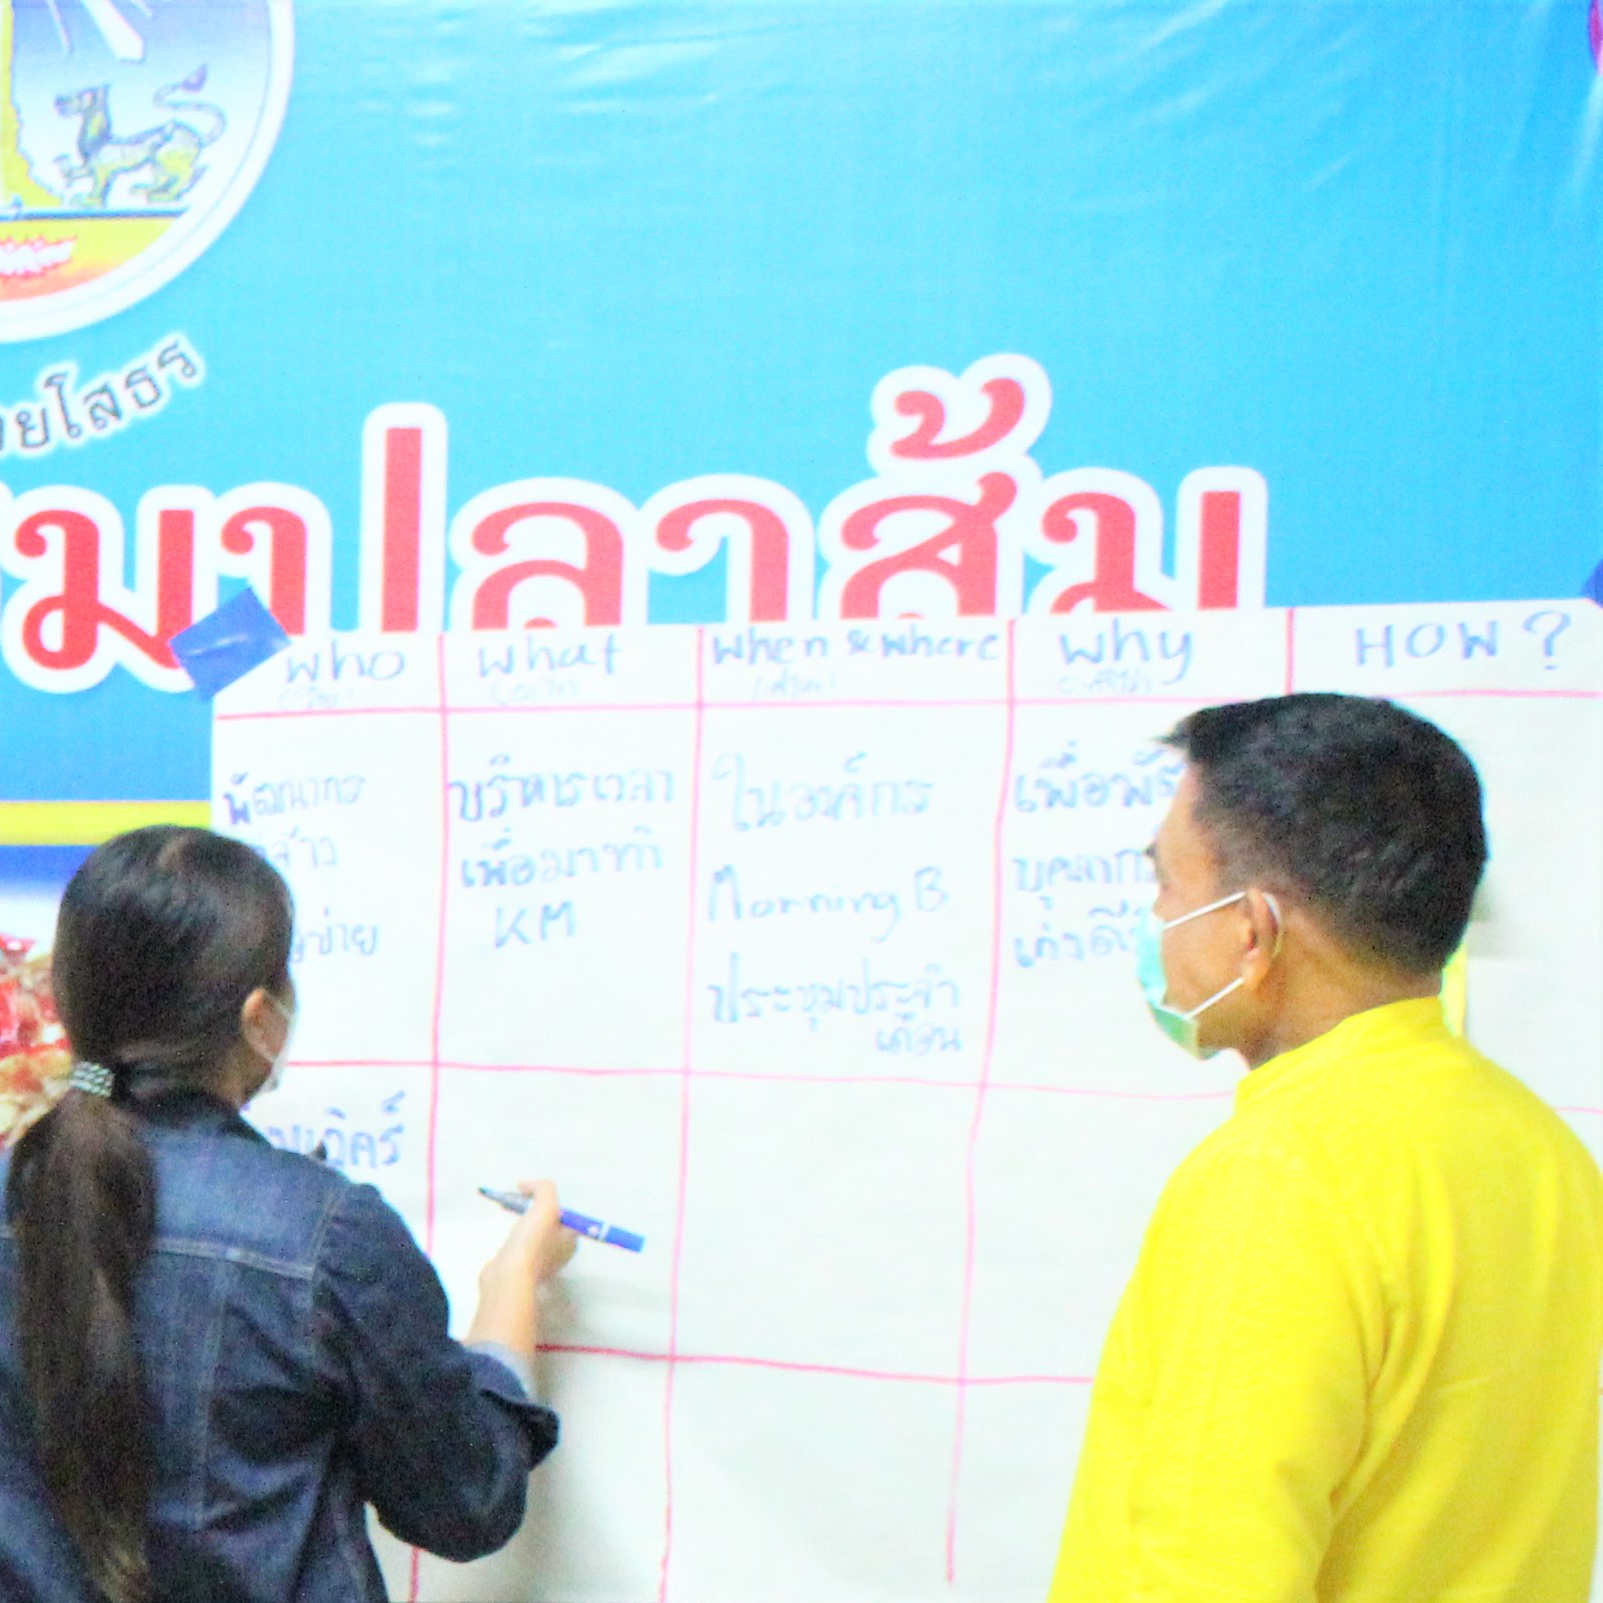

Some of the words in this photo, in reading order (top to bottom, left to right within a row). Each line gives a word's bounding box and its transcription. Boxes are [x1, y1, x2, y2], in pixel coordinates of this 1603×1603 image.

[1012, 848, 1156, 912] บุคลาก
[495, 900, 576, 950] KM
